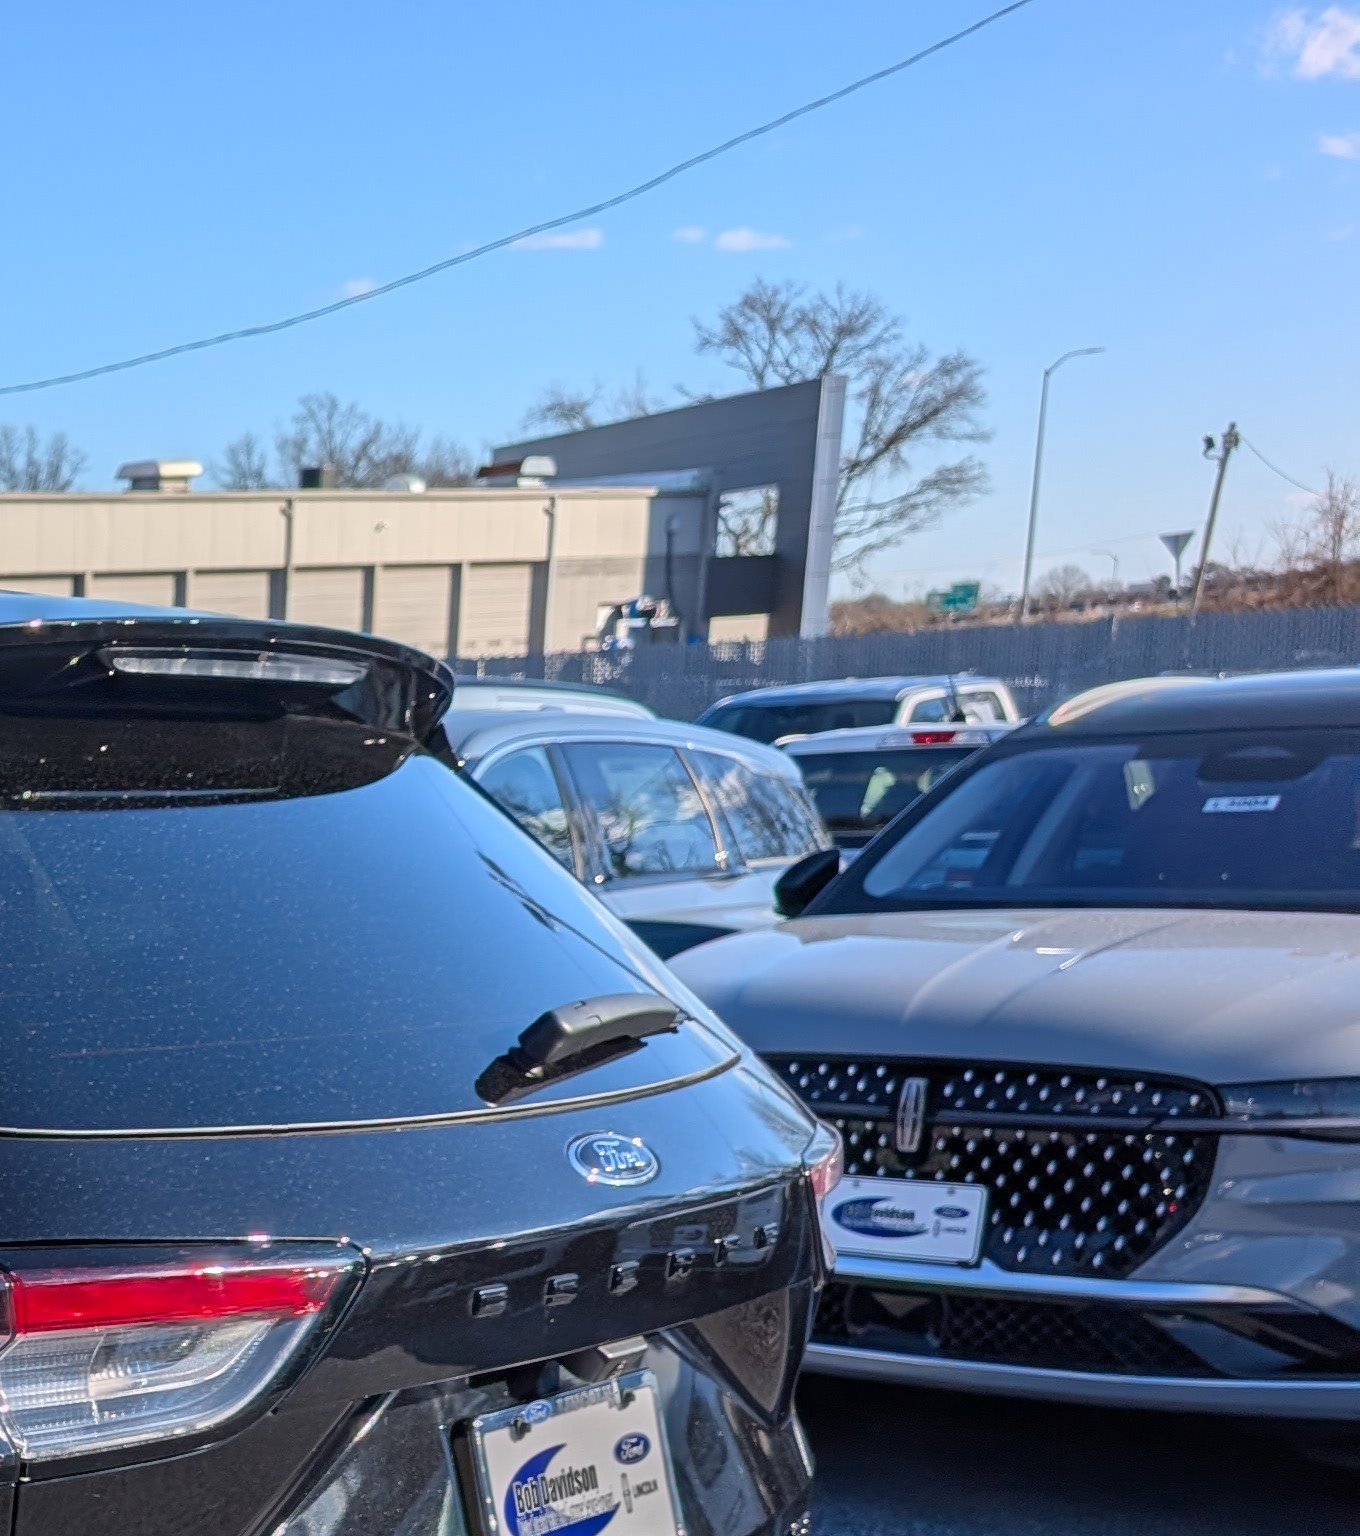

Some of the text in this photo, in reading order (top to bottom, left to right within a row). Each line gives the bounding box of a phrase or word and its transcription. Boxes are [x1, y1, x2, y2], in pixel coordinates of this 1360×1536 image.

[592, 1140, 648, 1172] Ford
[469, 1222, 780, 1319] ESCAPE
[620, 1437, 646, 1461] Ford
[514, 1465, 599, 1514] Bob Davidson
